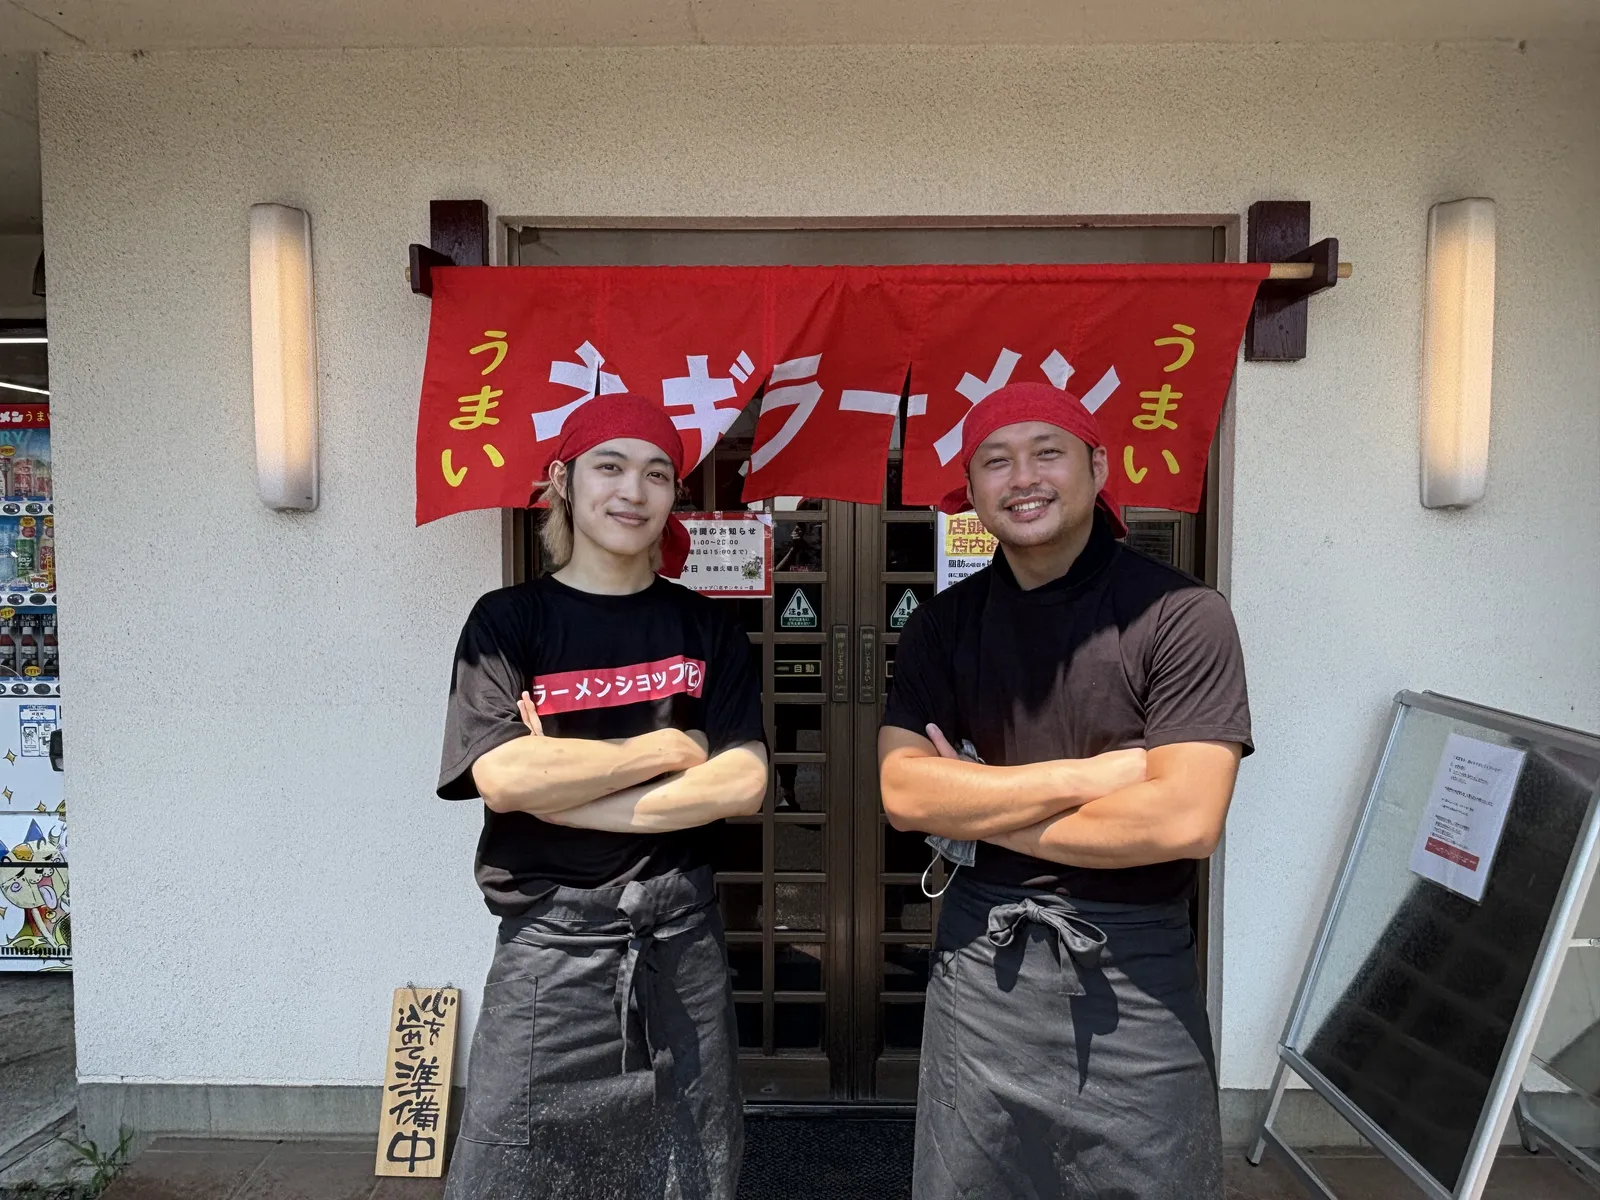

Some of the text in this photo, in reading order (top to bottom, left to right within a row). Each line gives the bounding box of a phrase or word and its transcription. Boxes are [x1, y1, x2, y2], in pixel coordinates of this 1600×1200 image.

[441, 330, 508, 488] うまい
[1123, 323, 1196, 484] うまい
